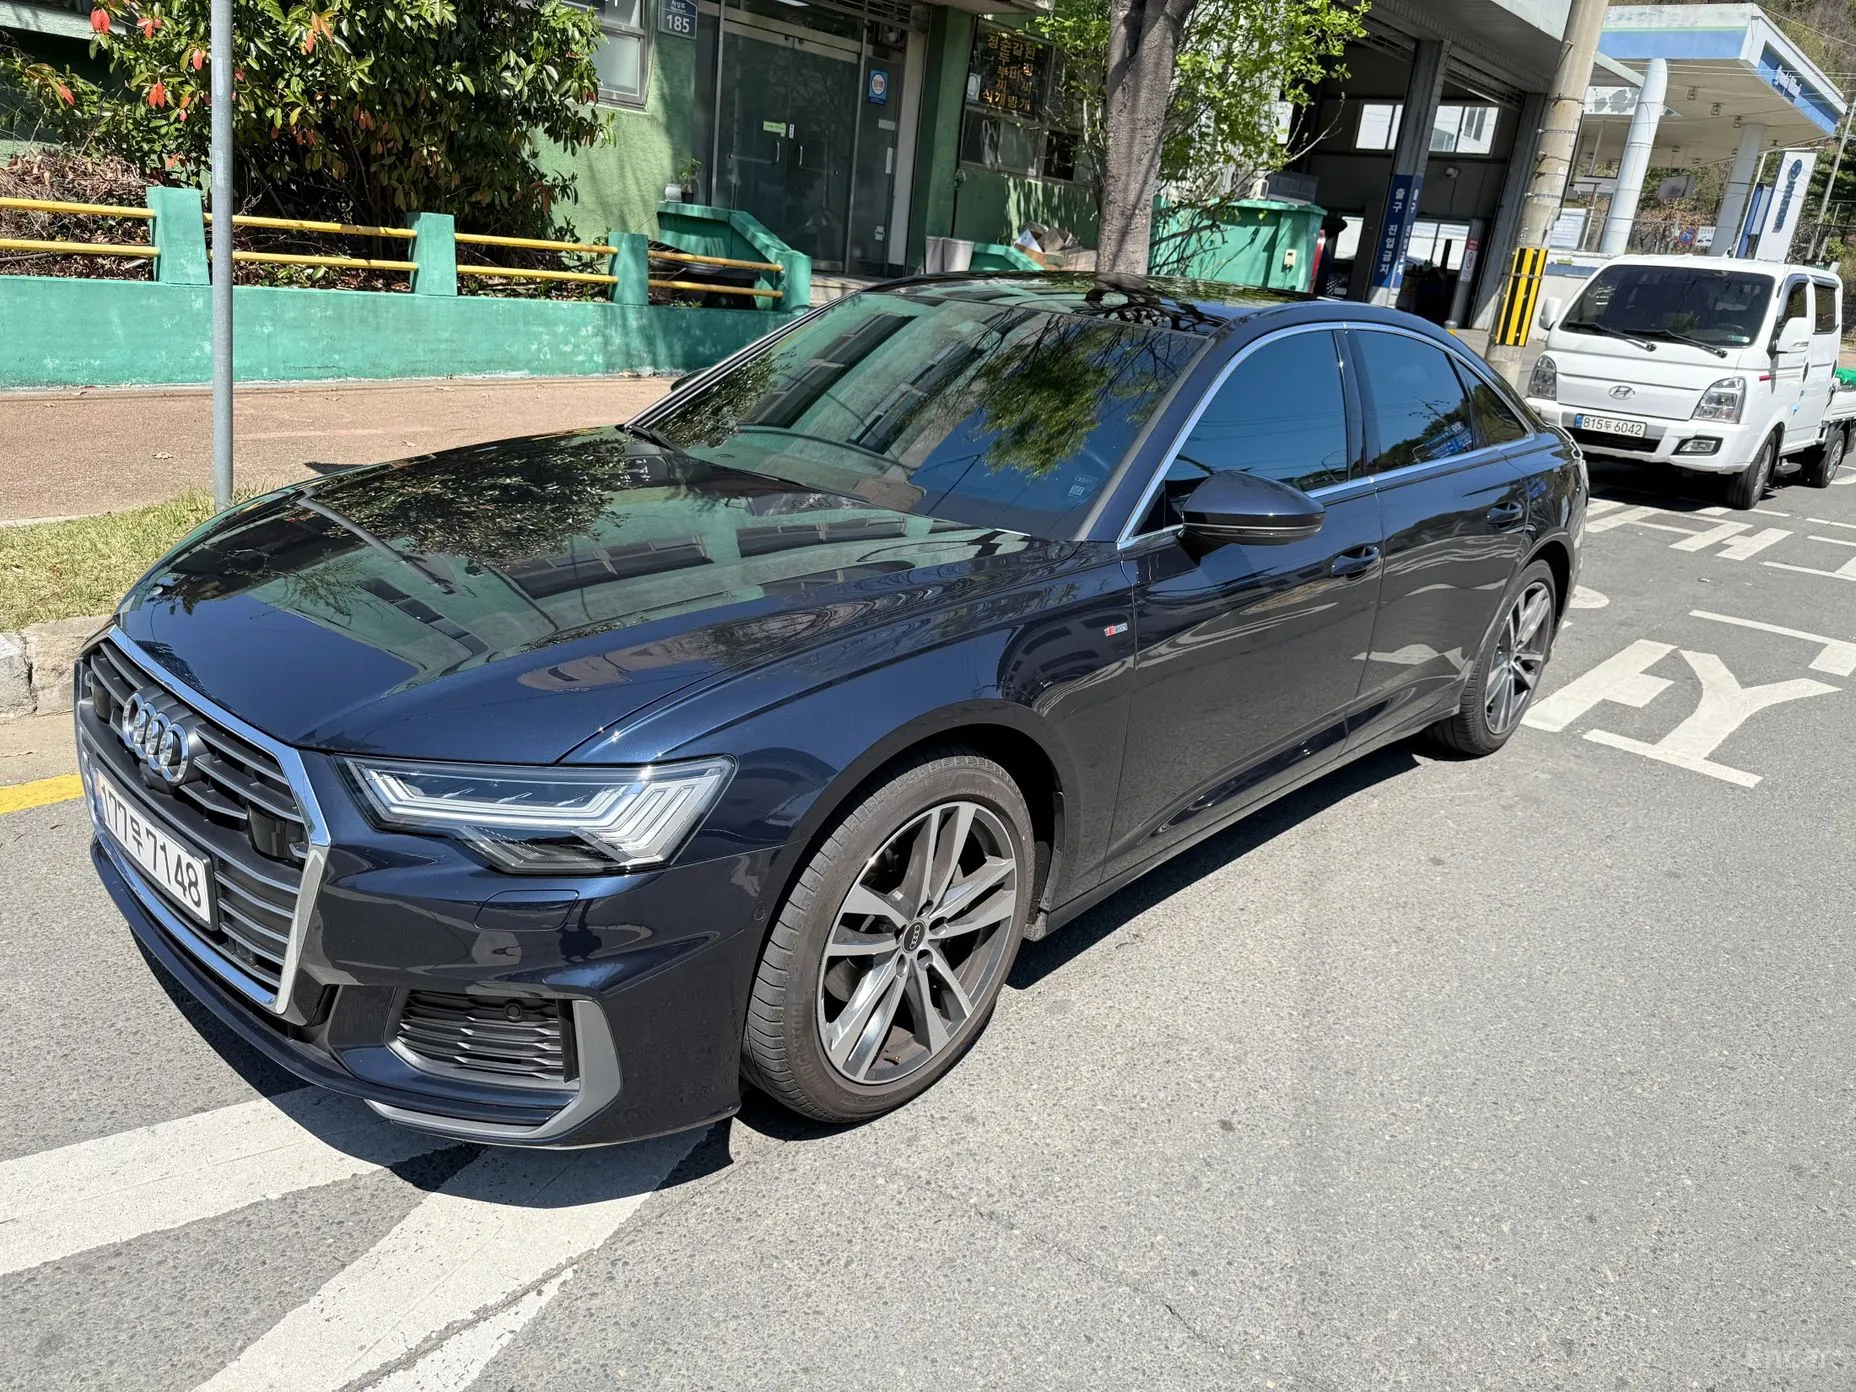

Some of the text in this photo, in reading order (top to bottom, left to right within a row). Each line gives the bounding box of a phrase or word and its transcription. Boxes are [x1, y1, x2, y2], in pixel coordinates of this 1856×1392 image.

[666, 14, 690, 33] 185
[1379, 188, 1405, 276] 출구 진입금지
[1583, 417, 1643, 436] 815두 6042
[101, 783, 202, 908] 177무 7148
